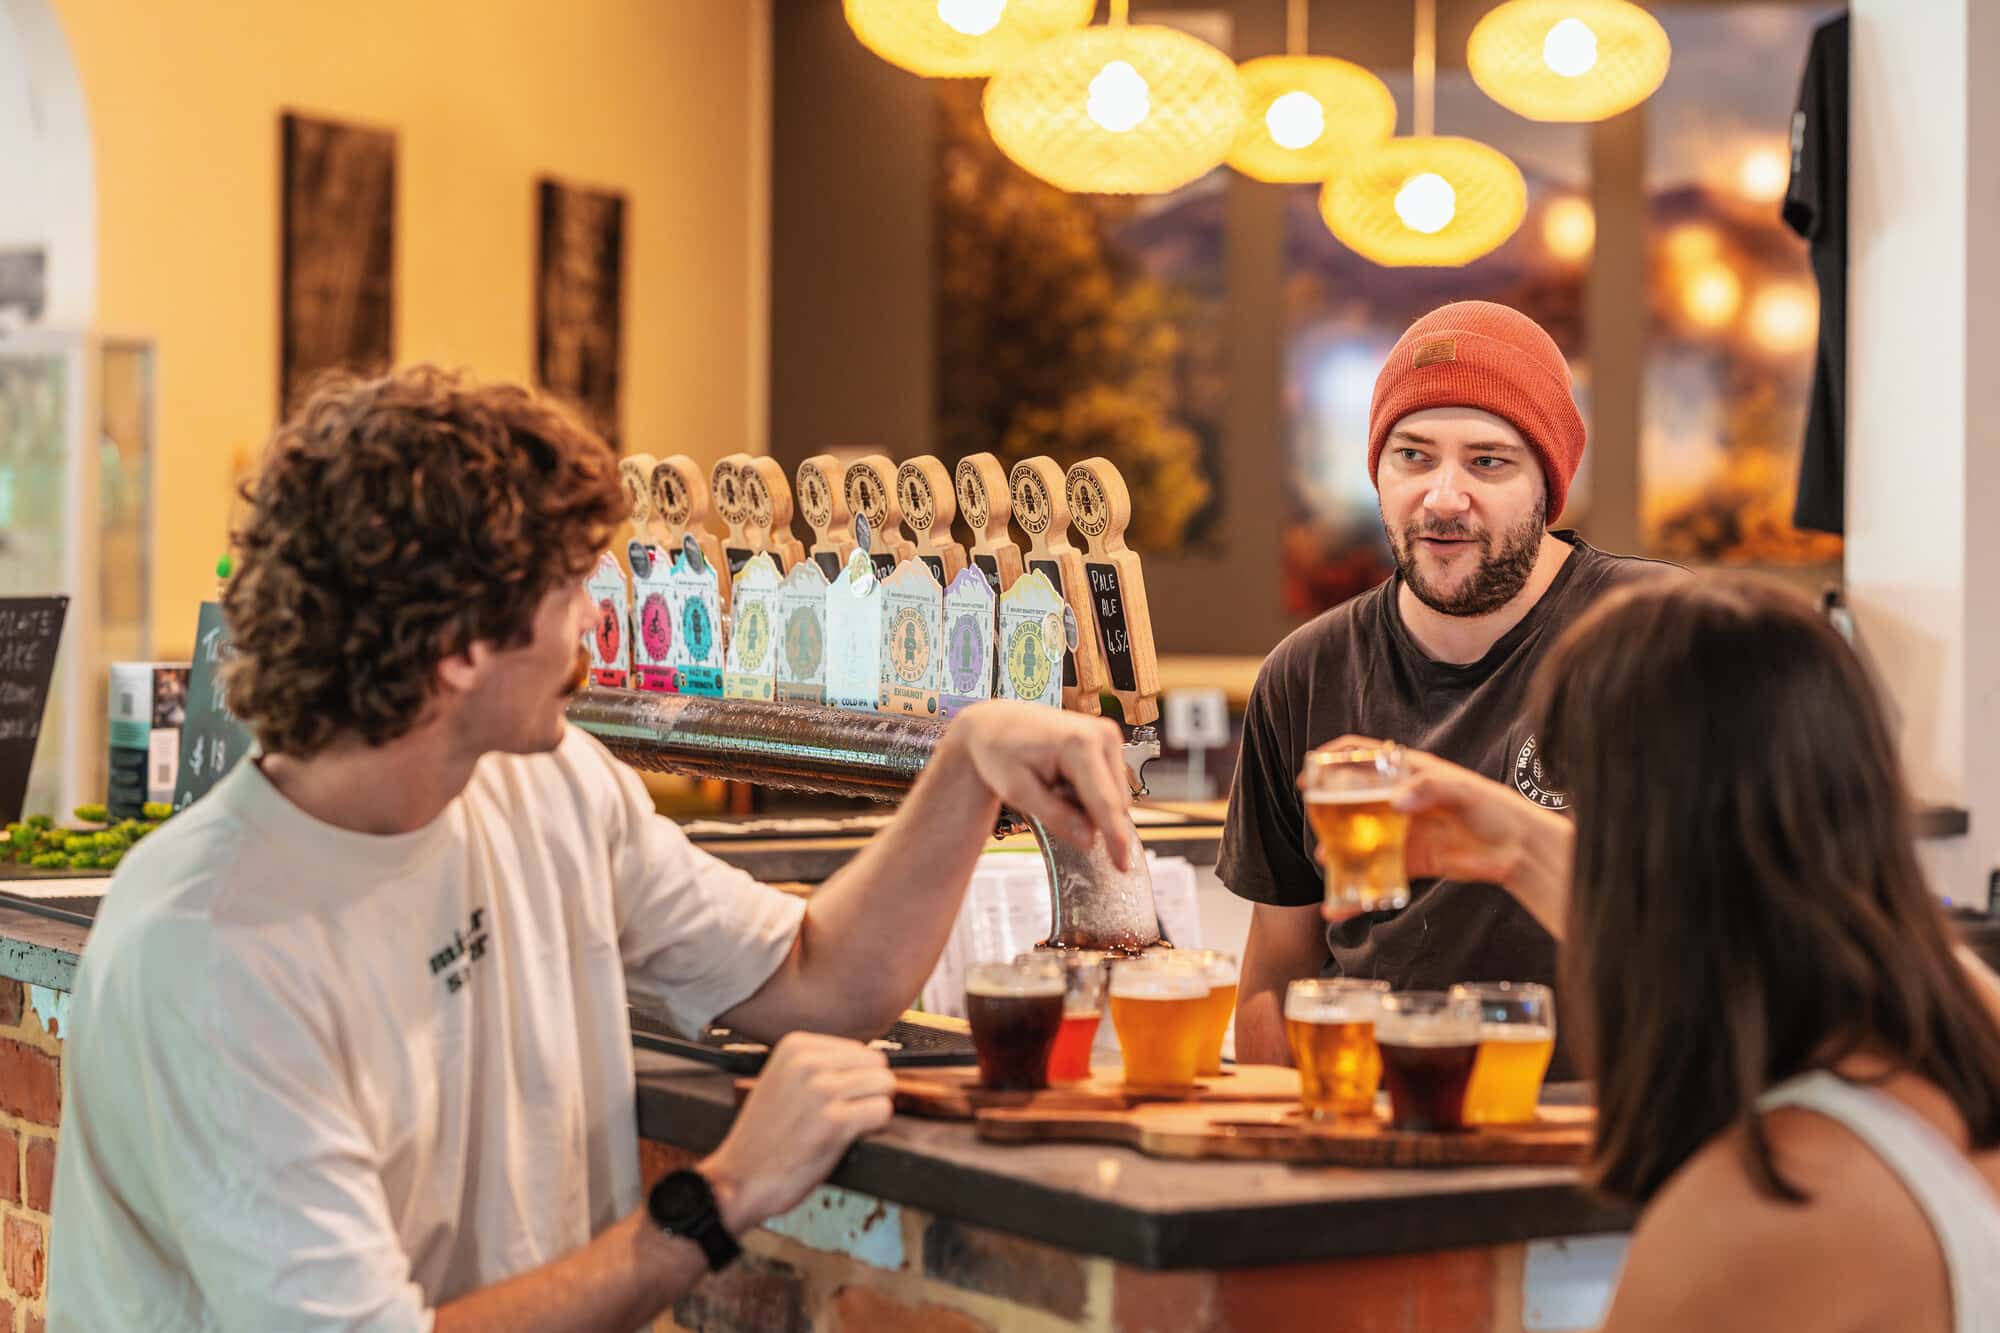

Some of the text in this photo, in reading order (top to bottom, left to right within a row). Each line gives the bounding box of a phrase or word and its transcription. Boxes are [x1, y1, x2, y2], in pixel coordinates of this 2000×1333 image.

[1011, 468, 1047, 501] MOUNTAIN MONK
[1066, 469, 1104, 502] MOUNTAIN MONK
[1090, 569, 1116, 593] PALE
[1101, 597, 1117, 617] ALE
[841, 697, 858, 707] COLD
[903, 701, 914, 712] IPA
[1517, 737, 1537, 769] MOU
[1520, 779, 1564, 806] BREW
